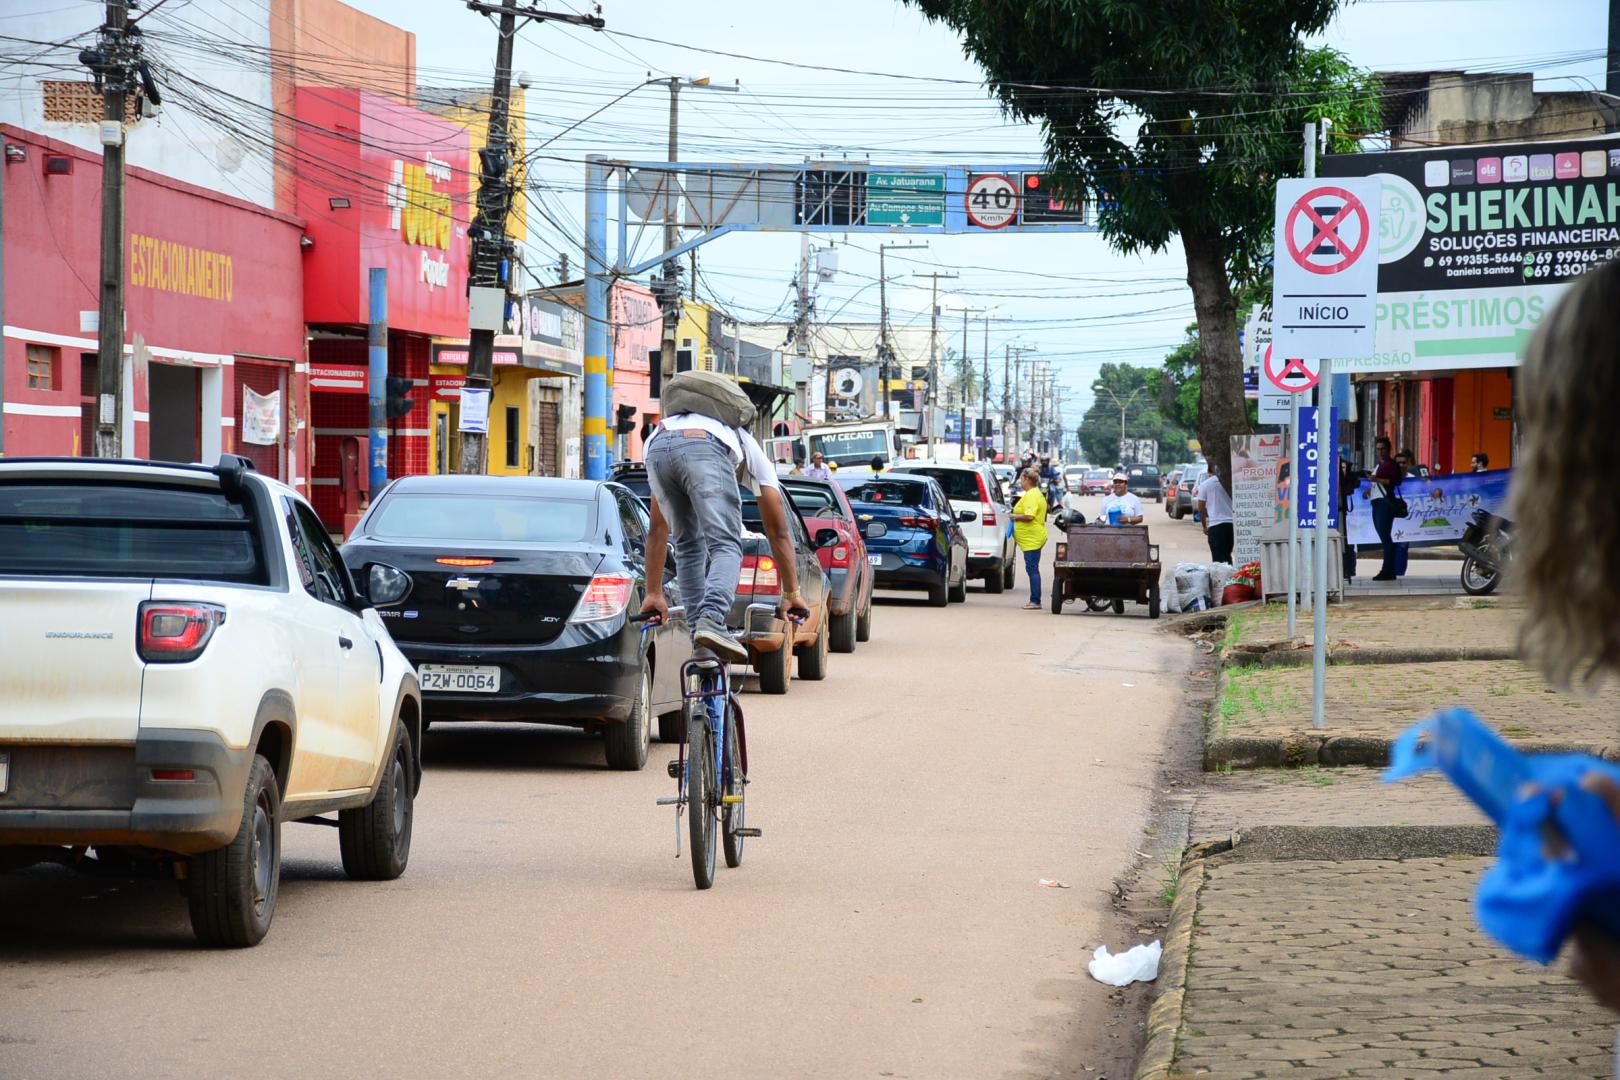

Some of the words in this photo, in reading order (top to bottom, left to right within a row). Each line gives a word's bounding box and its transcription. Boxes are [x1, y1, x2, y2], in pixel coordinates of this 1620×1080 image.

[891, 176, 936, 186] Jatuarana
[972, 187, 1011, 209] 40
[1430, 232, 1518, 252] SOLUÇÕES
[1522, 228, 1620, 246] FINANCEIRA
[1438, 256, 1452, 266] 69
[1456, 252, 1522, 266] 99355-5646
[1536, 252, 1552, 264] 69
[130, 233, 233, 303] ESTACIONAMENTO
[1447, 267, 1481, 276] Daniela
[1483, 266, 1514, 275] Santos
[1534, 265, 1550, 277] 69
[1299, 302, 1349, 320] INÍCIO
[1376, 294, 1545, 330] PRÉSTIMOS
[1333, 350, 1412, 368] MPRESSÃO
[308, 368, 364, 377] ESTACIONAMENTO
[436, 379, 466, 387] ESTACIONA
[822, 434, 836, 443] MV
[838, 431, 874, 441] CECATO
[1306, 431, 1318, 513] HOTEL
[45, 632, 114, 640] ENDURANCE
